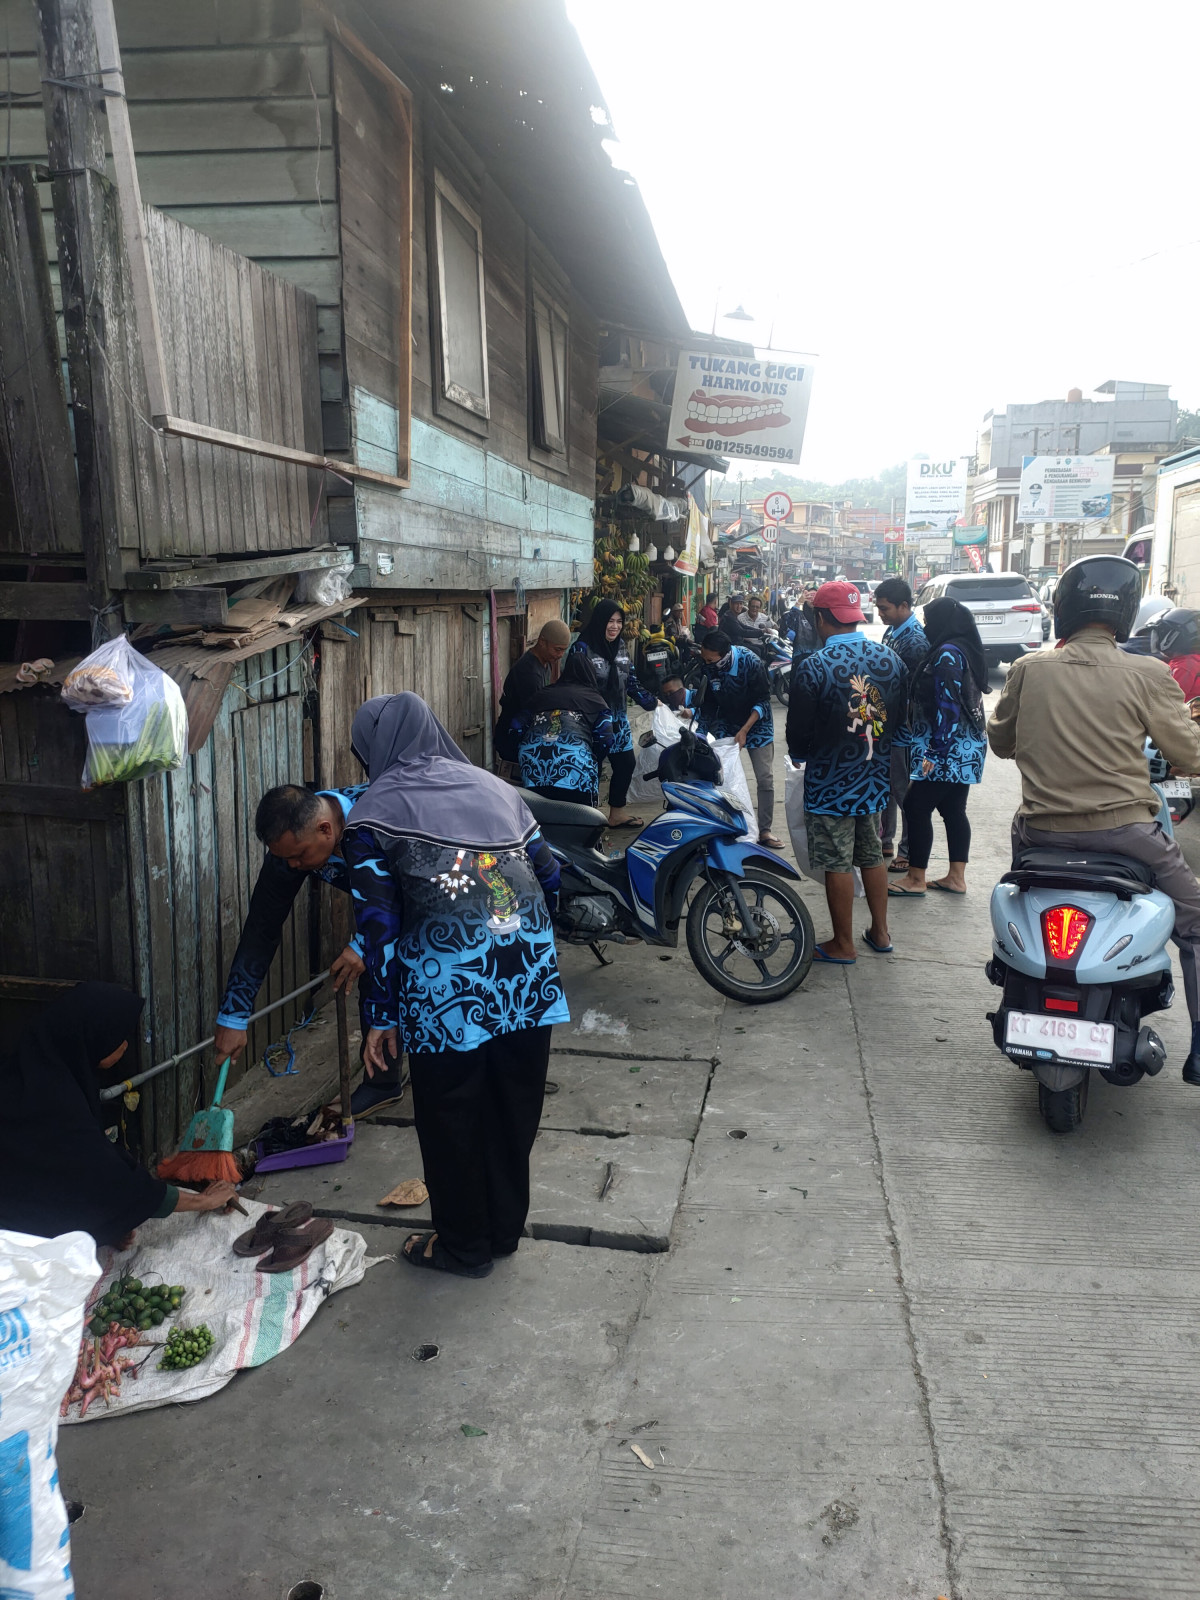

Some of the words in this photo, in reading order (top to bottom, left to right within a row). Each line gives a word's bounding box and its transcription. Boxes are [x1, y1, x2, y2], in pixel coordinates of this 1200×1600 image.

[689, 356, 761, 377] TUKANG
[765, 365, 805, 381] GIGI
[702, 375, 788, 396] HARMONIS
[706, 439, 794, 459] 08125549594
[920, 461, 954, 475] DKU
[1089, 593, 1119, 601] HONDA
[1009, 1015, 1030, 1034] KT
[1089, 1026, 1109, 1044] CX
[1011, 1047, 1033, 1057] YAMAHA
